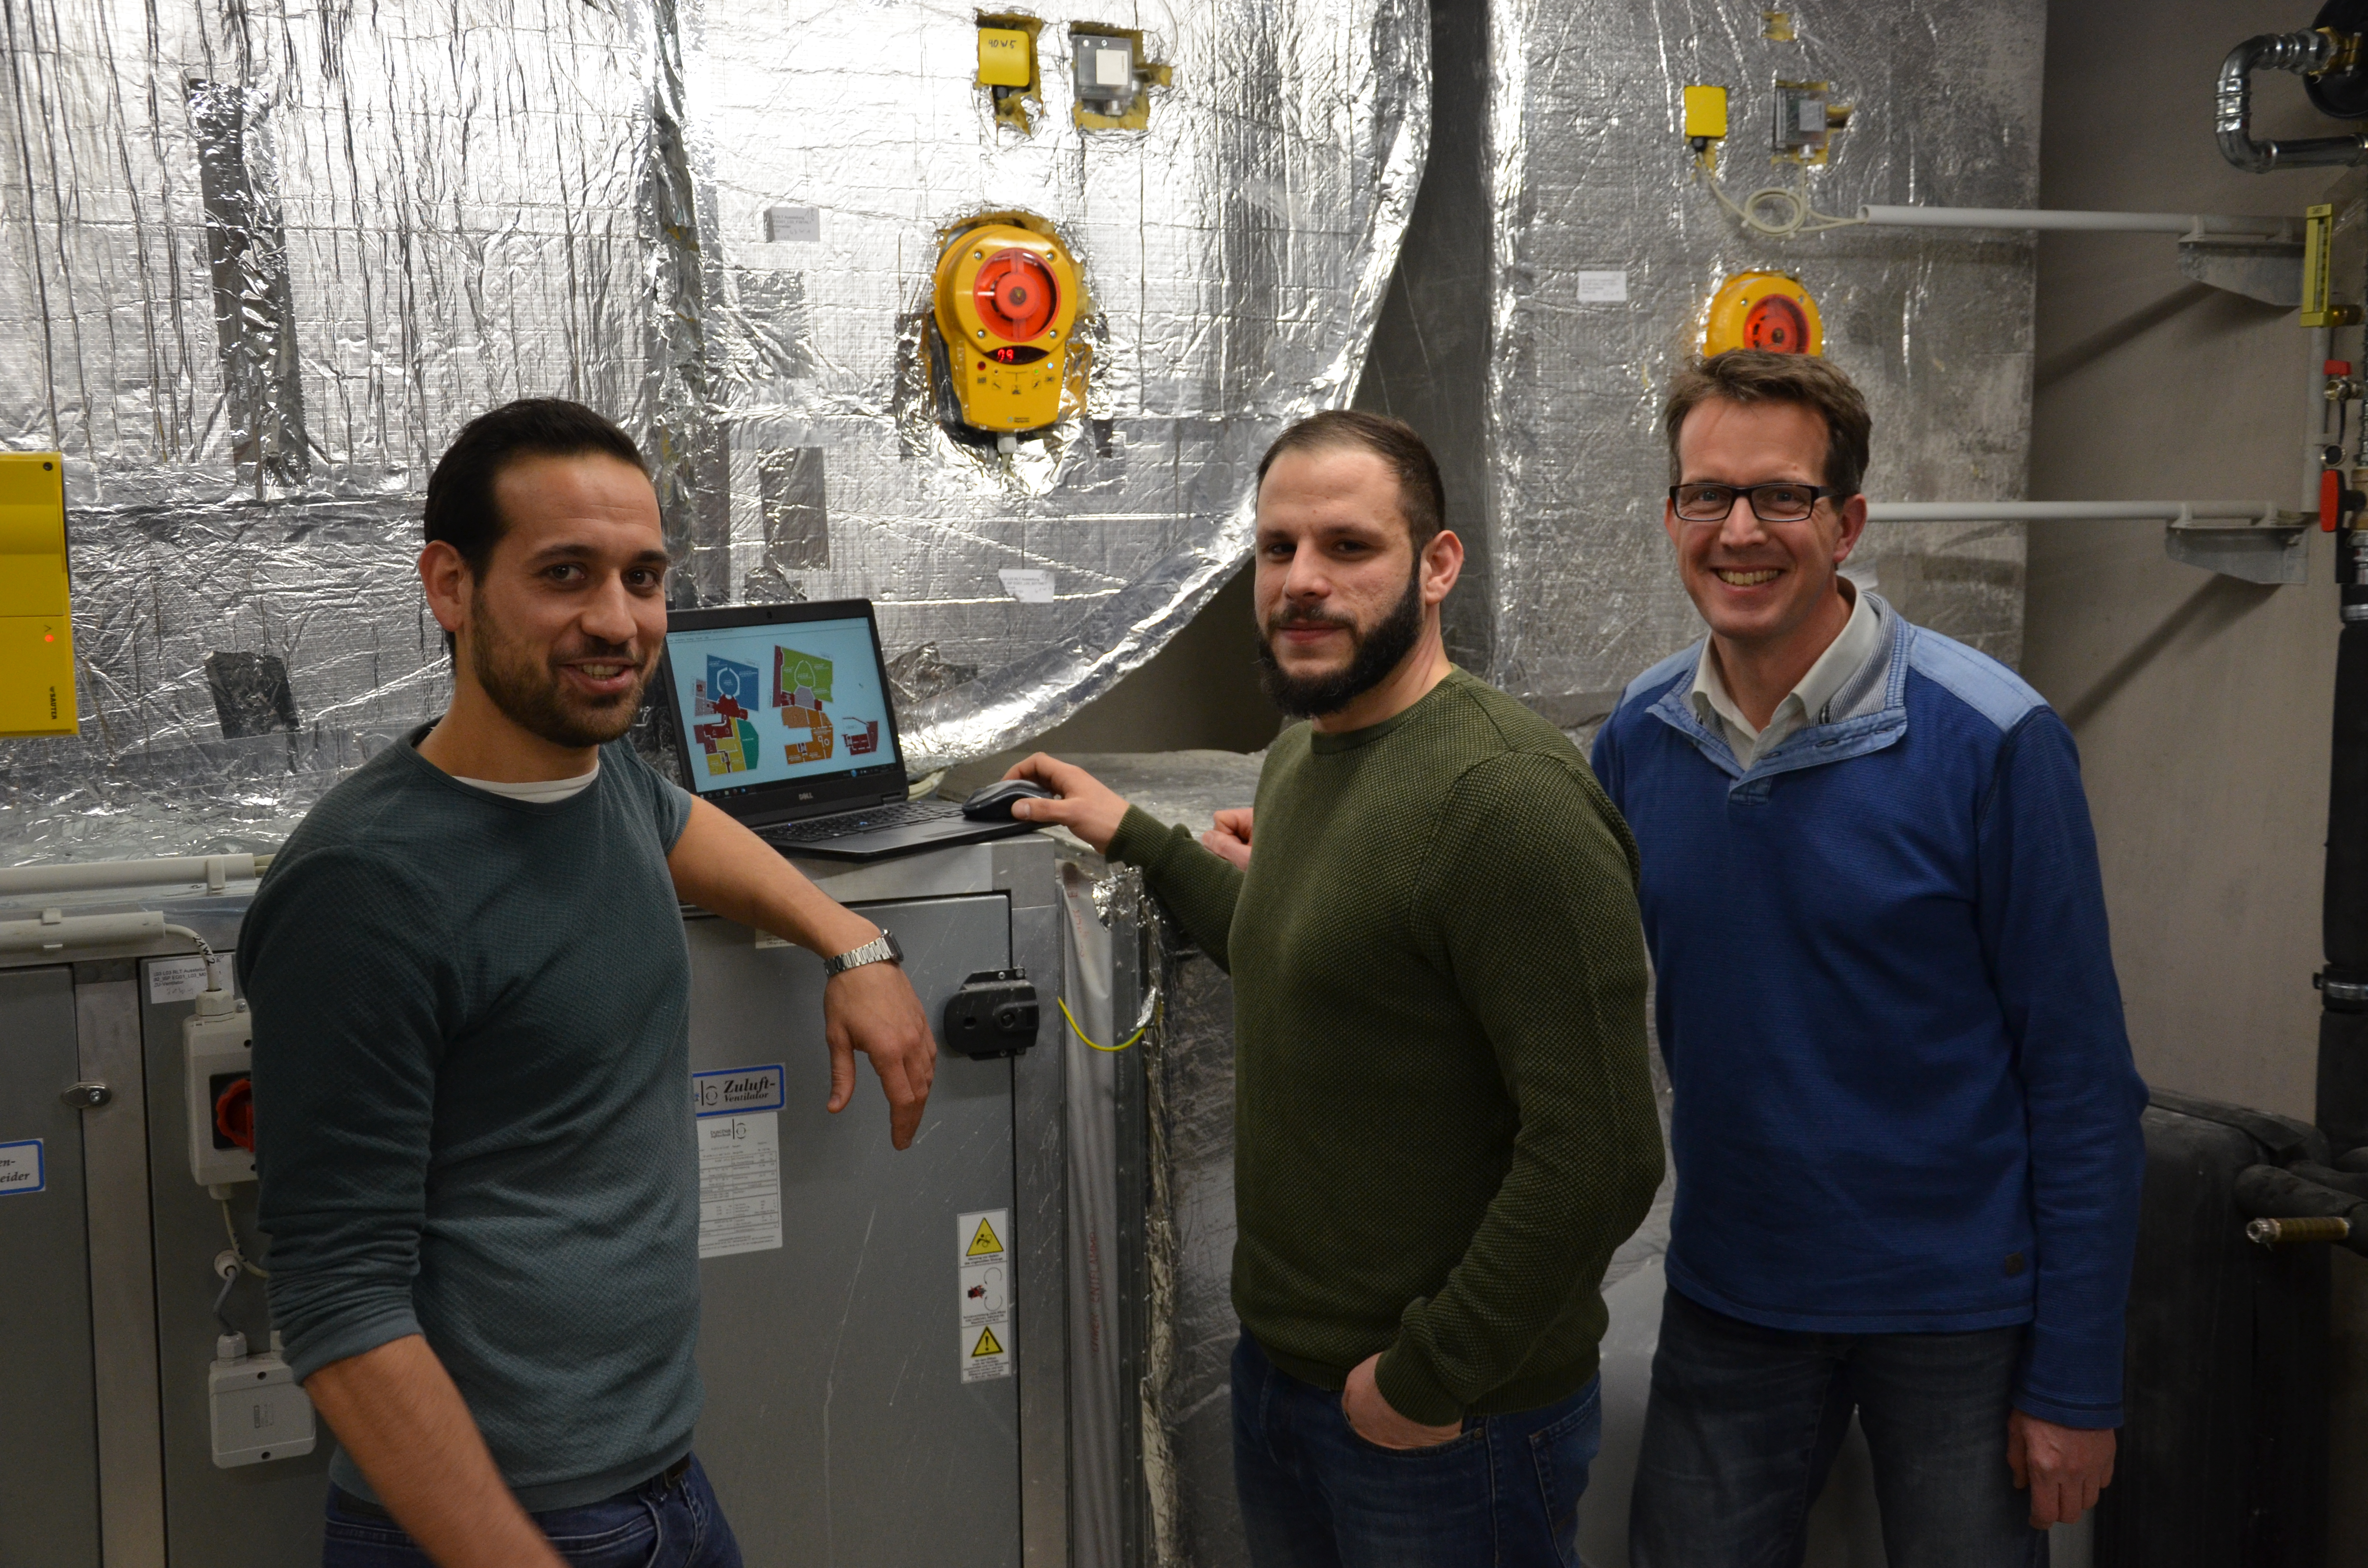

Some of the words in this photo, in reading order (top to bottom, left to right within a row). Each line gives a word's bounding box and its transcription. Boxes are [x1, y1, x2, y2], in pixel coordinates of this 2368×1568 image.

[724, 1076, 776, 1093] Zuluft-
[725, 1092, 768, 1102] Ventilator
[0, 1172, 30, 1183] eider
